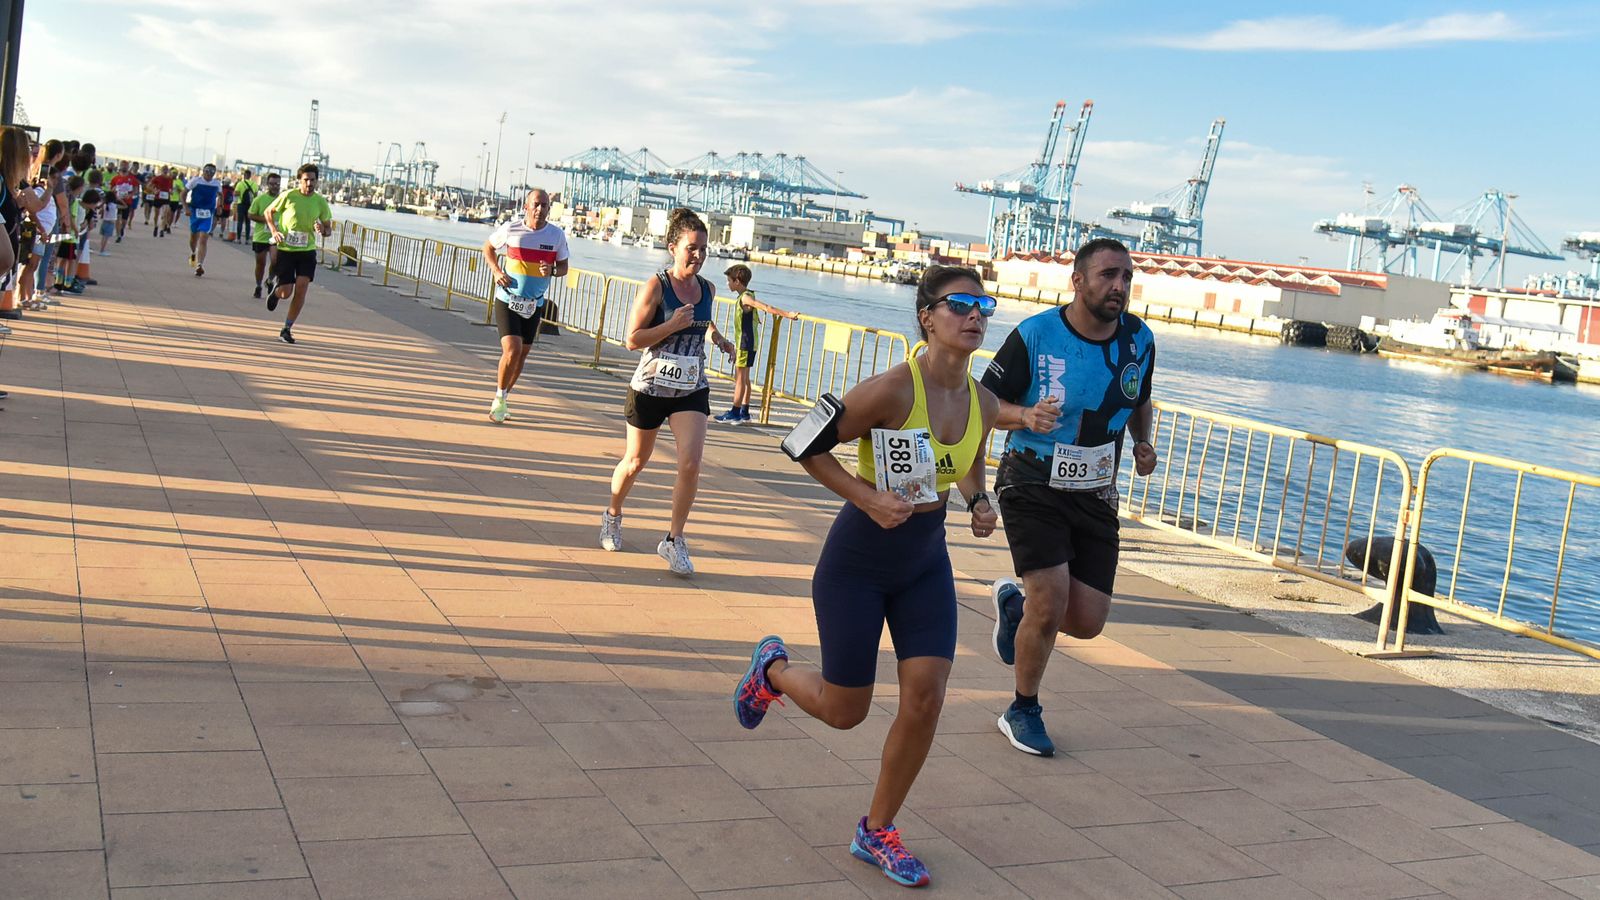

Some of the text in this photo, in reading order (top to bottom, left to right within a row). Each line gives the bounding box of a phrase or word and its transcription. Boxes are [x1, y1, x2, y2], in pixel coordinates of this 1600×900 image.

[510, 301, 524, 312] 269
[1038, 354, 1046, 368] DE
[659, 364, 682, 380] 440
[1038, 369, 1046, 382] LA
[1047, 354, 1066, 430] JIME
[915, 432, 926, 448] XXI
[888, 437, 913, 474] 588
[935, 466, 957, 475] didas
[1058, 461, 1088, 478] 693
